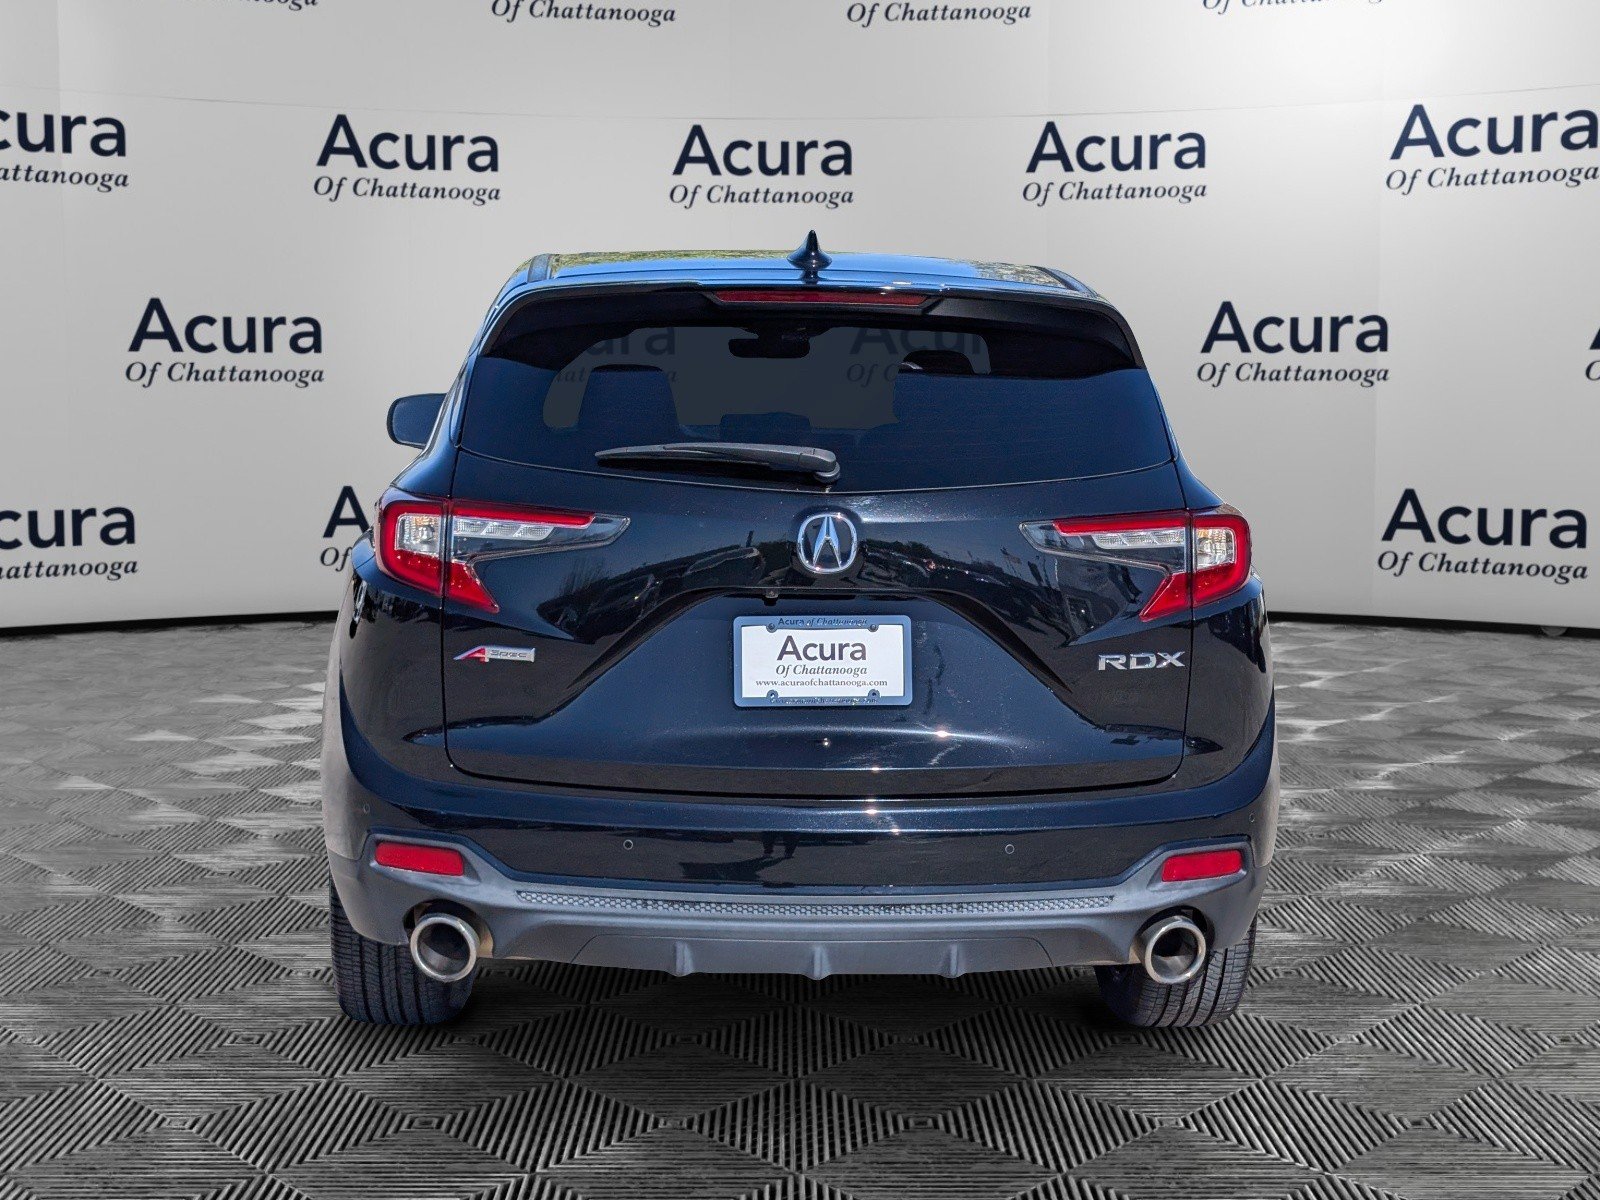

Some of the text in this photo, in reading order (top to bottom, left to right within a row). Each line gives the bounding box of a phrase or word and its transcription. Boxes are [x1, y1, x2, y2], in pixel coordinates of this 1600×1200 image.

[491, 0, 676, 28] Of Chattanooga
[847, 1, 1031, 29] Of Chattanooga
[315, 113, 499, 173] Acura
[1389, 103, 1600, 161] Acura
[671, 123, 853, 178] Acura
[1025, 120, 1206, 174] Acura
[313, 175, 501, 207] Of Chattanooga
[1022, 180, 1207, 208] Of Chattanooga
[1385, 165, 1600, 196] Of Chattanooga
[669, 184, 854, 210] Of Chattanooga
[127, 296, 323, 355] Acura
[1199, 300, 1389, 355] Acura
[125, 361, 325, 389] Of Chattanooga
[1196, 362, 1390, 389] Of Chattanooga
[1380, 487, 1588, 550] Acura
[0, 560, 139, 582] attanooga
[319, 546, 353, 573] Of
[1377, 550, 1588, 585] Of Chattanooga
[778, 617, 805, 626] Acura
[776, 635, 867, 662] Acura
[1098, 651, 1186, 671] RDX
[755, 678, 888, 688] www.acuraofchattanooga.com
[775, 664, 868, 679] Of Chattanooga
